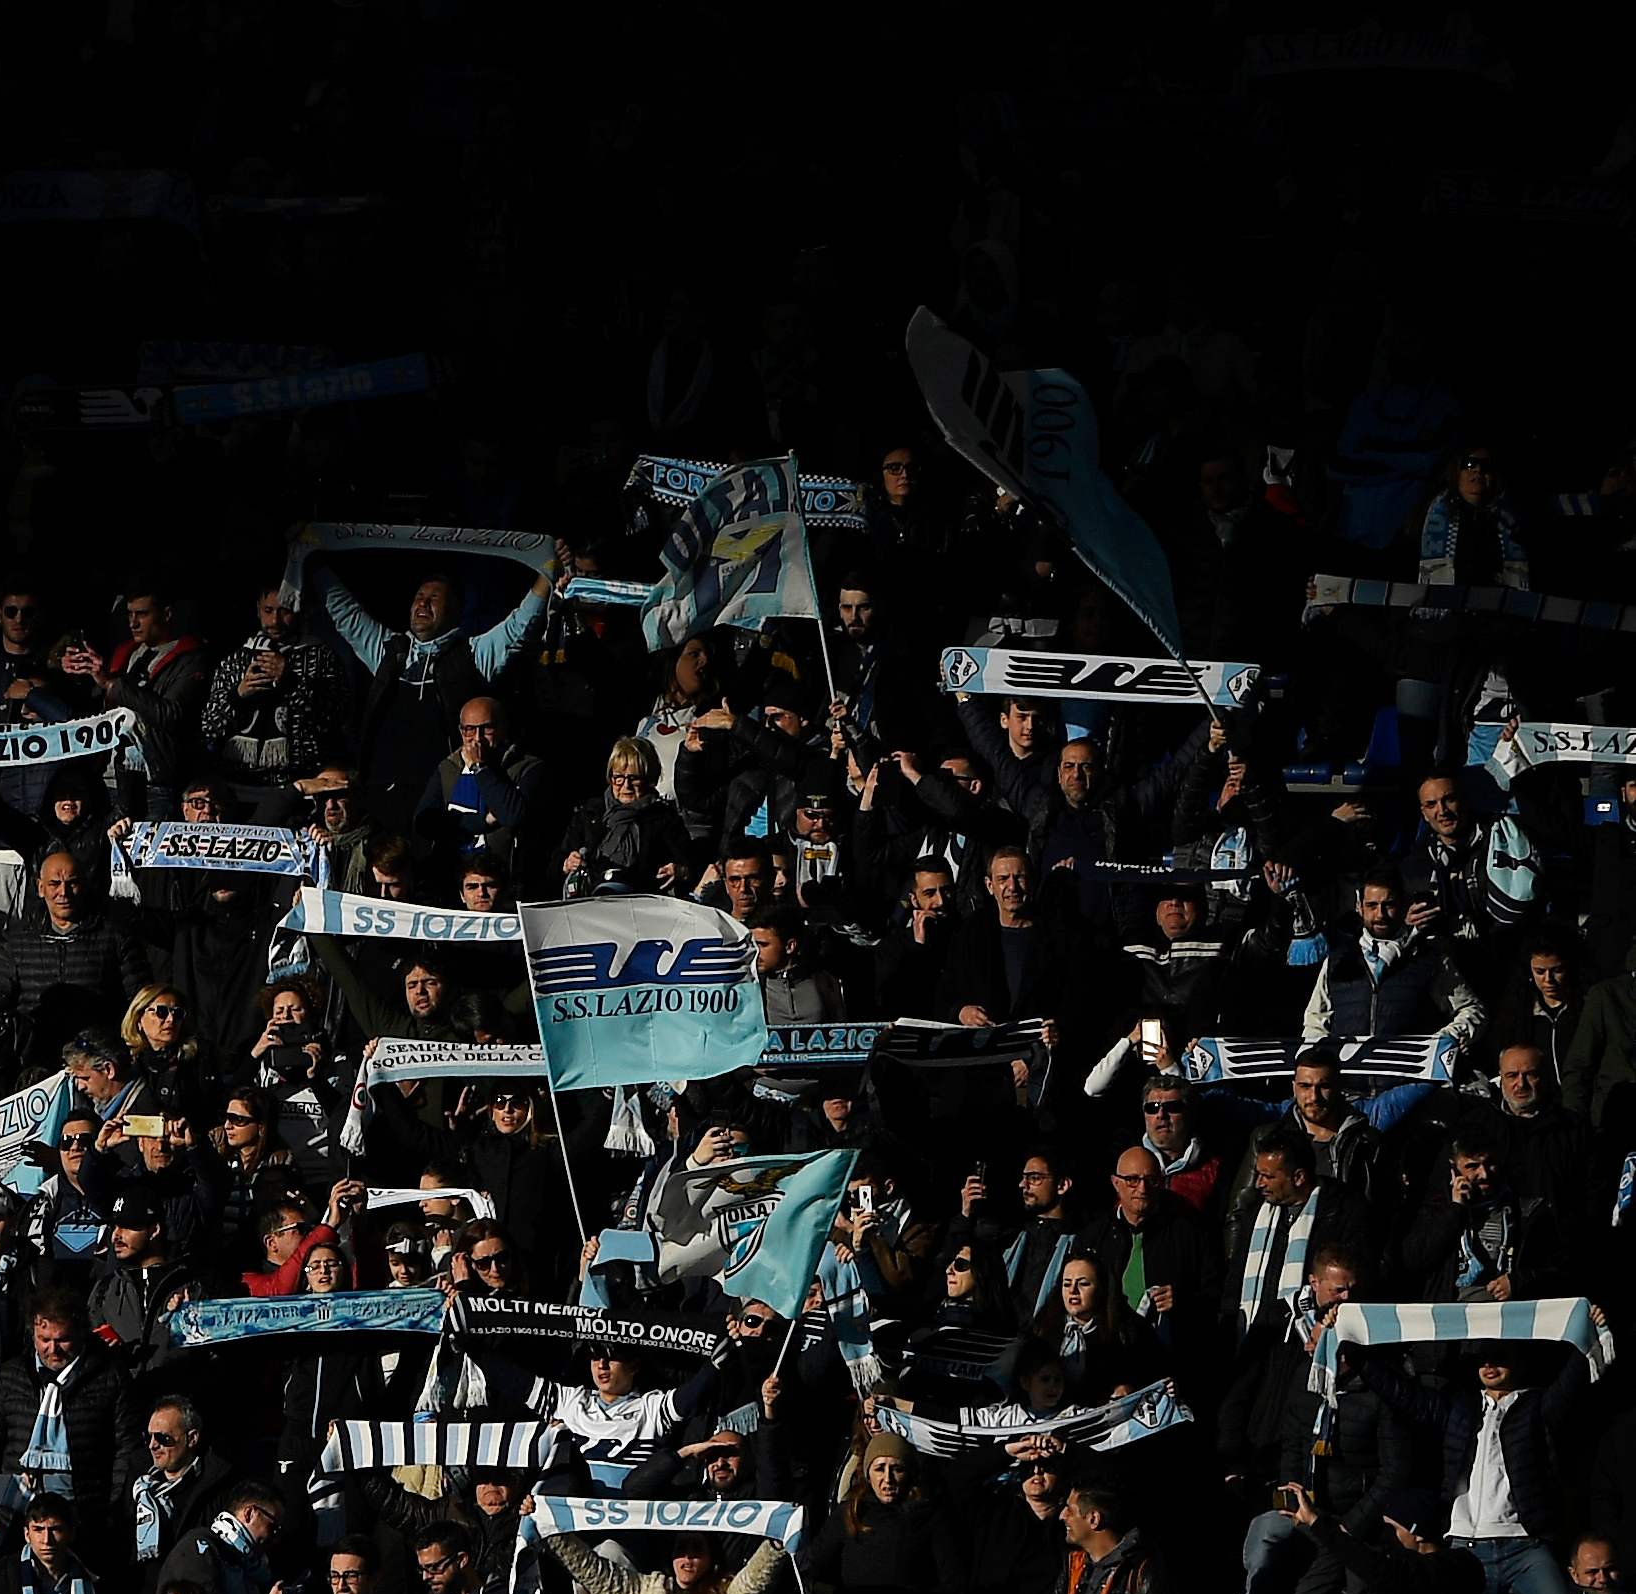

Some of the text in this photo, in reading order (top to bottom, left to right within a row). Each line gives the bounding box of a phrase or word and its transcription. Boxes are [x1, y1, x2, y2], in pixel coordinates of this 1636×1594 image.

[1533, 730, 1636, 757] S.S.LAZ
[353, 908, 522, 941] ss lazio
[689, 985, 739, 1014] 1900
[792, 1028, 878, 1052] LAZIO
[371, 1052, 528, 1068] SQUADRA DELLA
[469, 1295, 531, 1316] MOLTI
[575, 1316, 717, 1350] MOLTO ONORE
[584, 1498, 764, 1528] ss lazio
